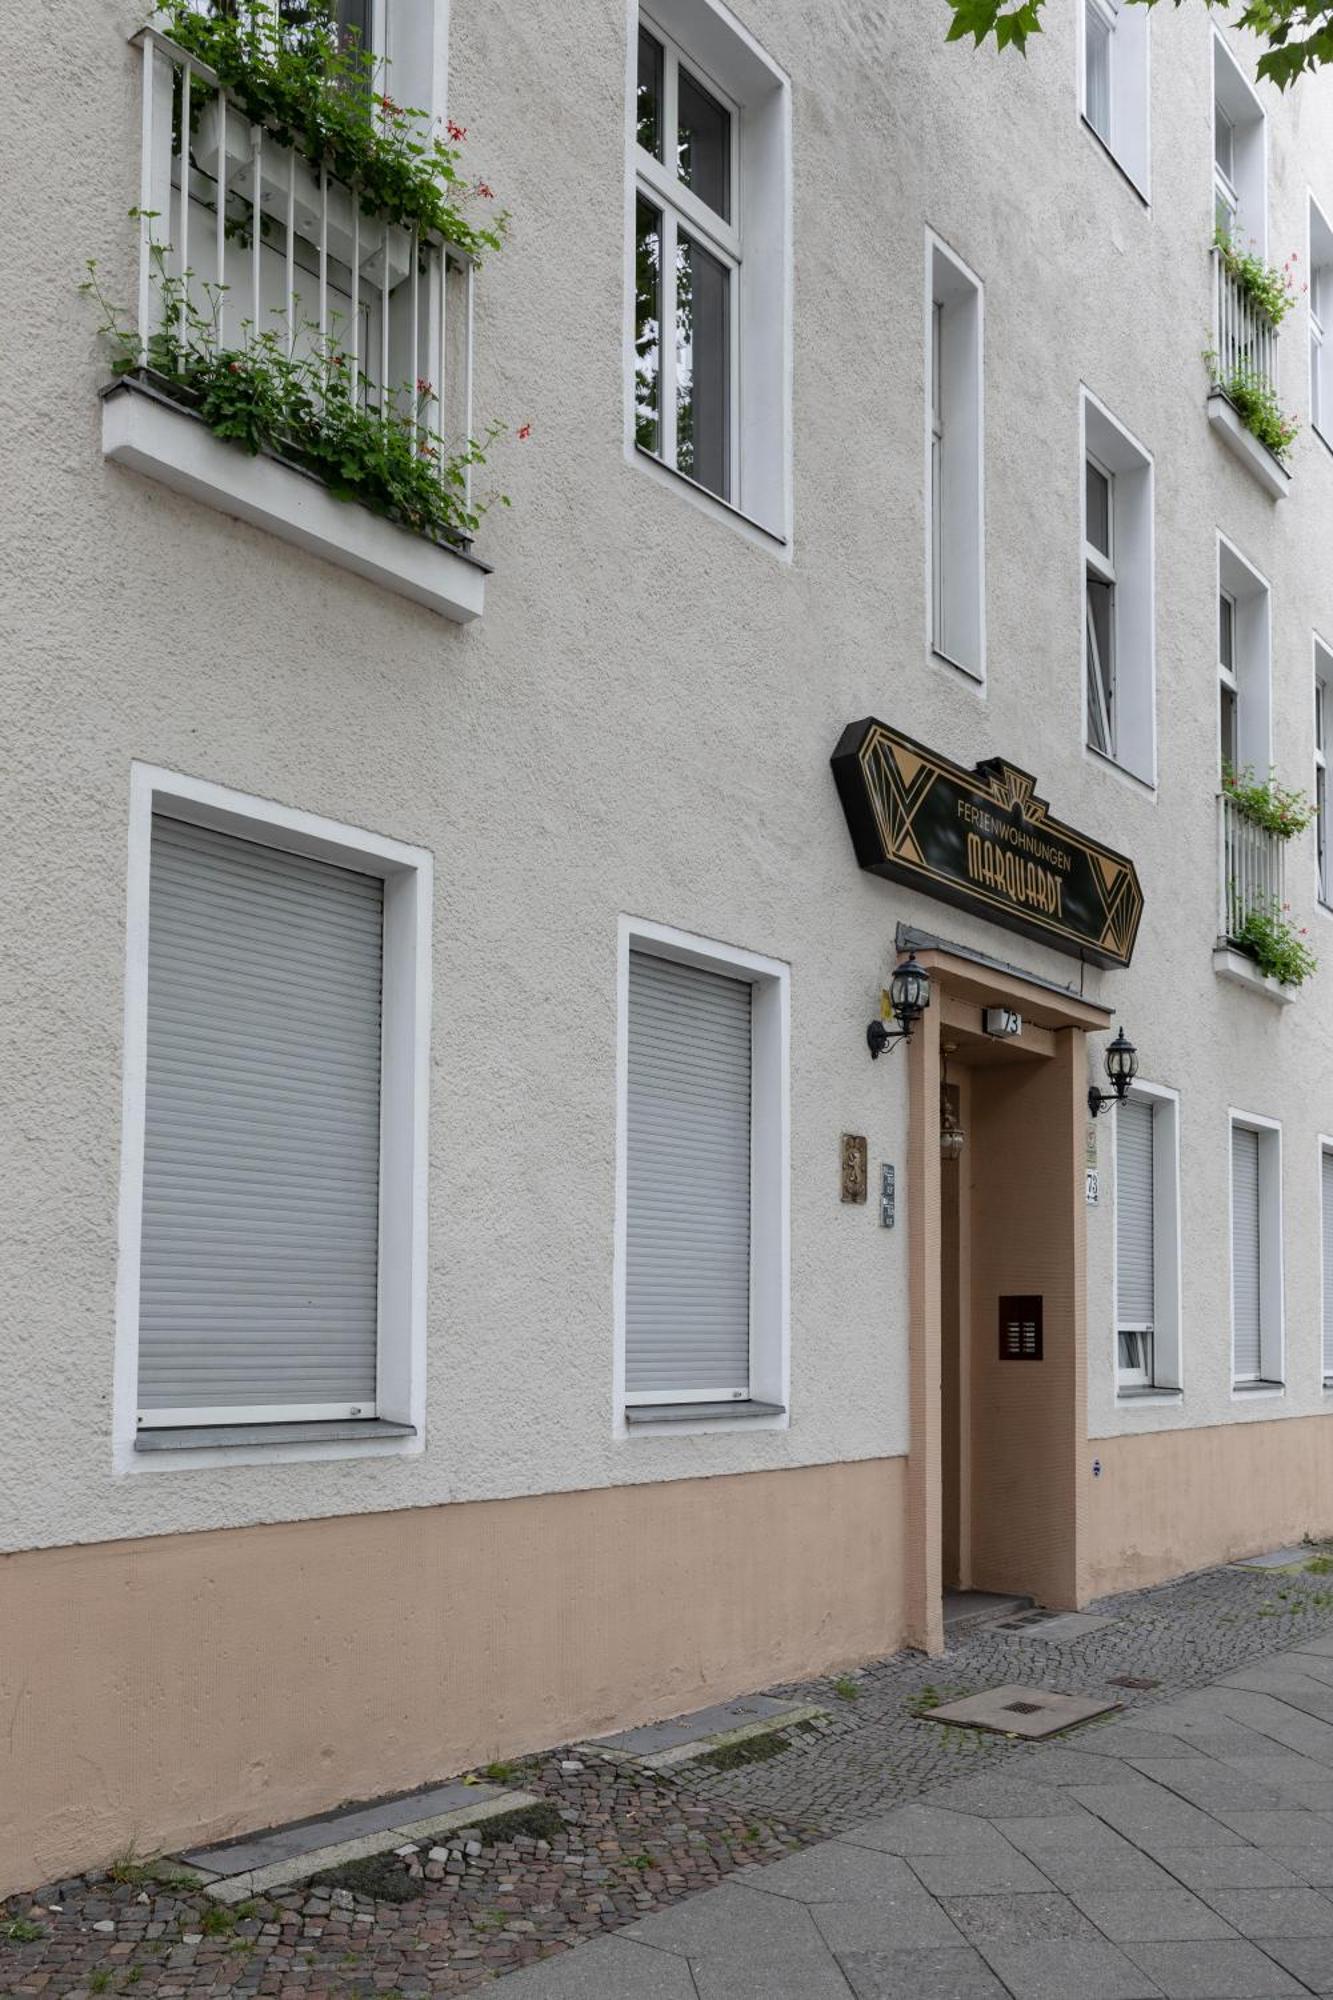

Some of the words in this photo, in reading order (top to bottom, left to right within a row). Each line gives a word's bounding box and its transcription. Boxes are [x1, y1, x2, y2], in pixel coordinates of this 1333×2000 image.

[957, 800, 1071, 871] FERIENWOHNUNGEN
[967, 832, 1062, 918] MARQUARDT
[1003, 1009, 1018, 1033] 73
[1087, 1174, 1098, 1194] 73
